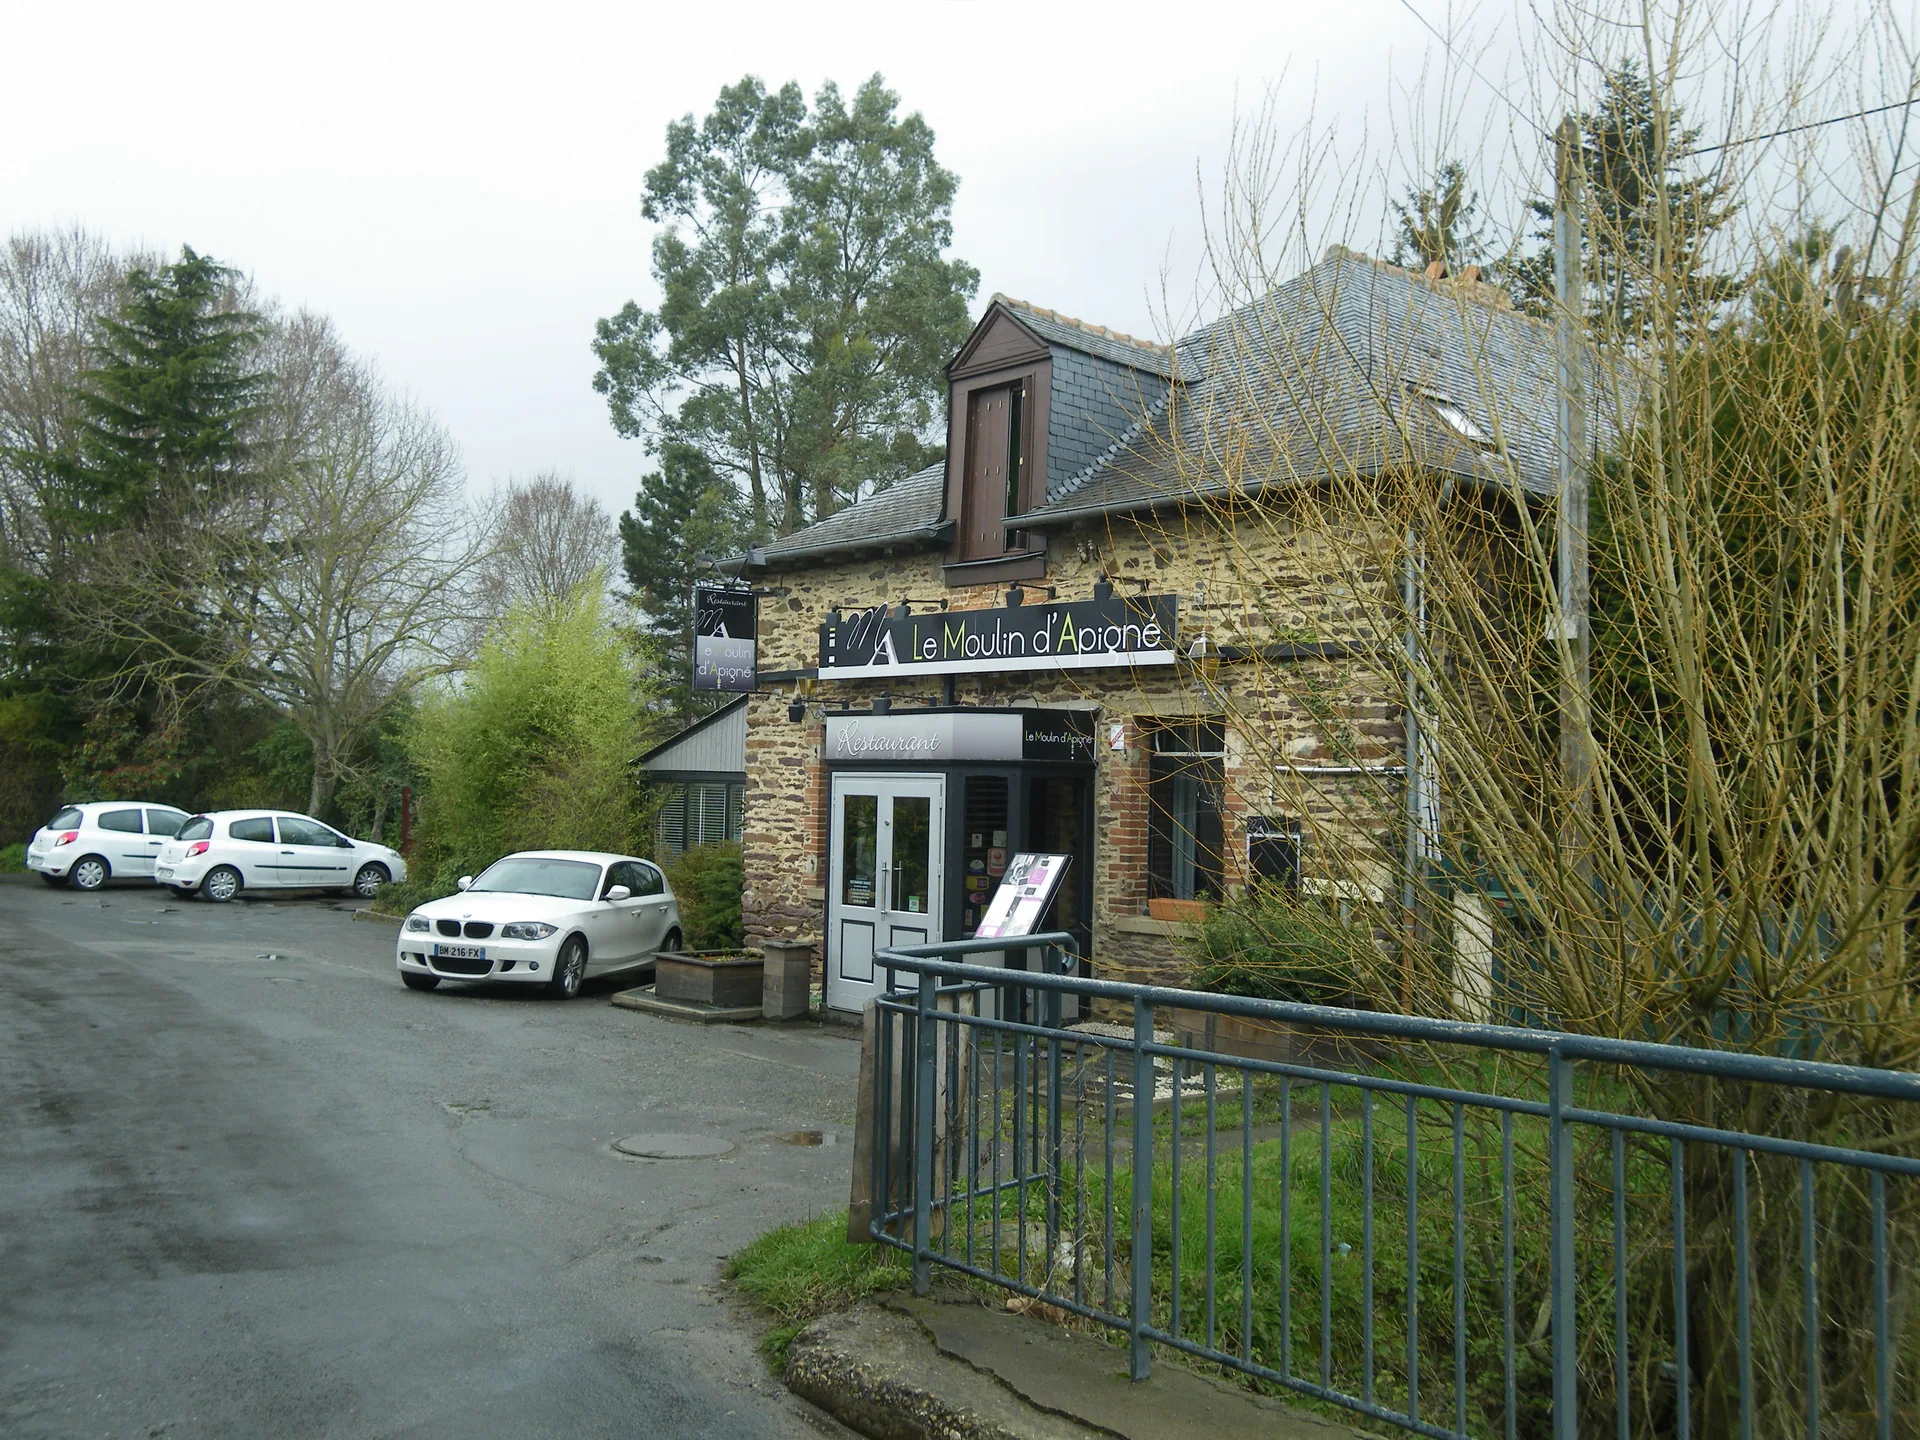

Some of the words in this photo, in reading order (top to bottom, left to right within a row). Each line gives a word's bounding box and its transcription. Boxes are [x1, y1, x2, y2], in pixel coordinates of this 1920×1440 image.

[707, 593, 747, 606] Restaurant
[913, 624, 938, 660] Le
[943, 617, 1025, 659] Moulin
[1033, 611, 1161, 667] d'Apigné
[698, 660, 752, 684] d'Apigné
[837, 718, 941, 756] Restaurant
[1025, 730, 1034, 742] Le
[1035, 730, 1060, 743] Moulin
[1060, 731, 1092, 748] d'Apigné
